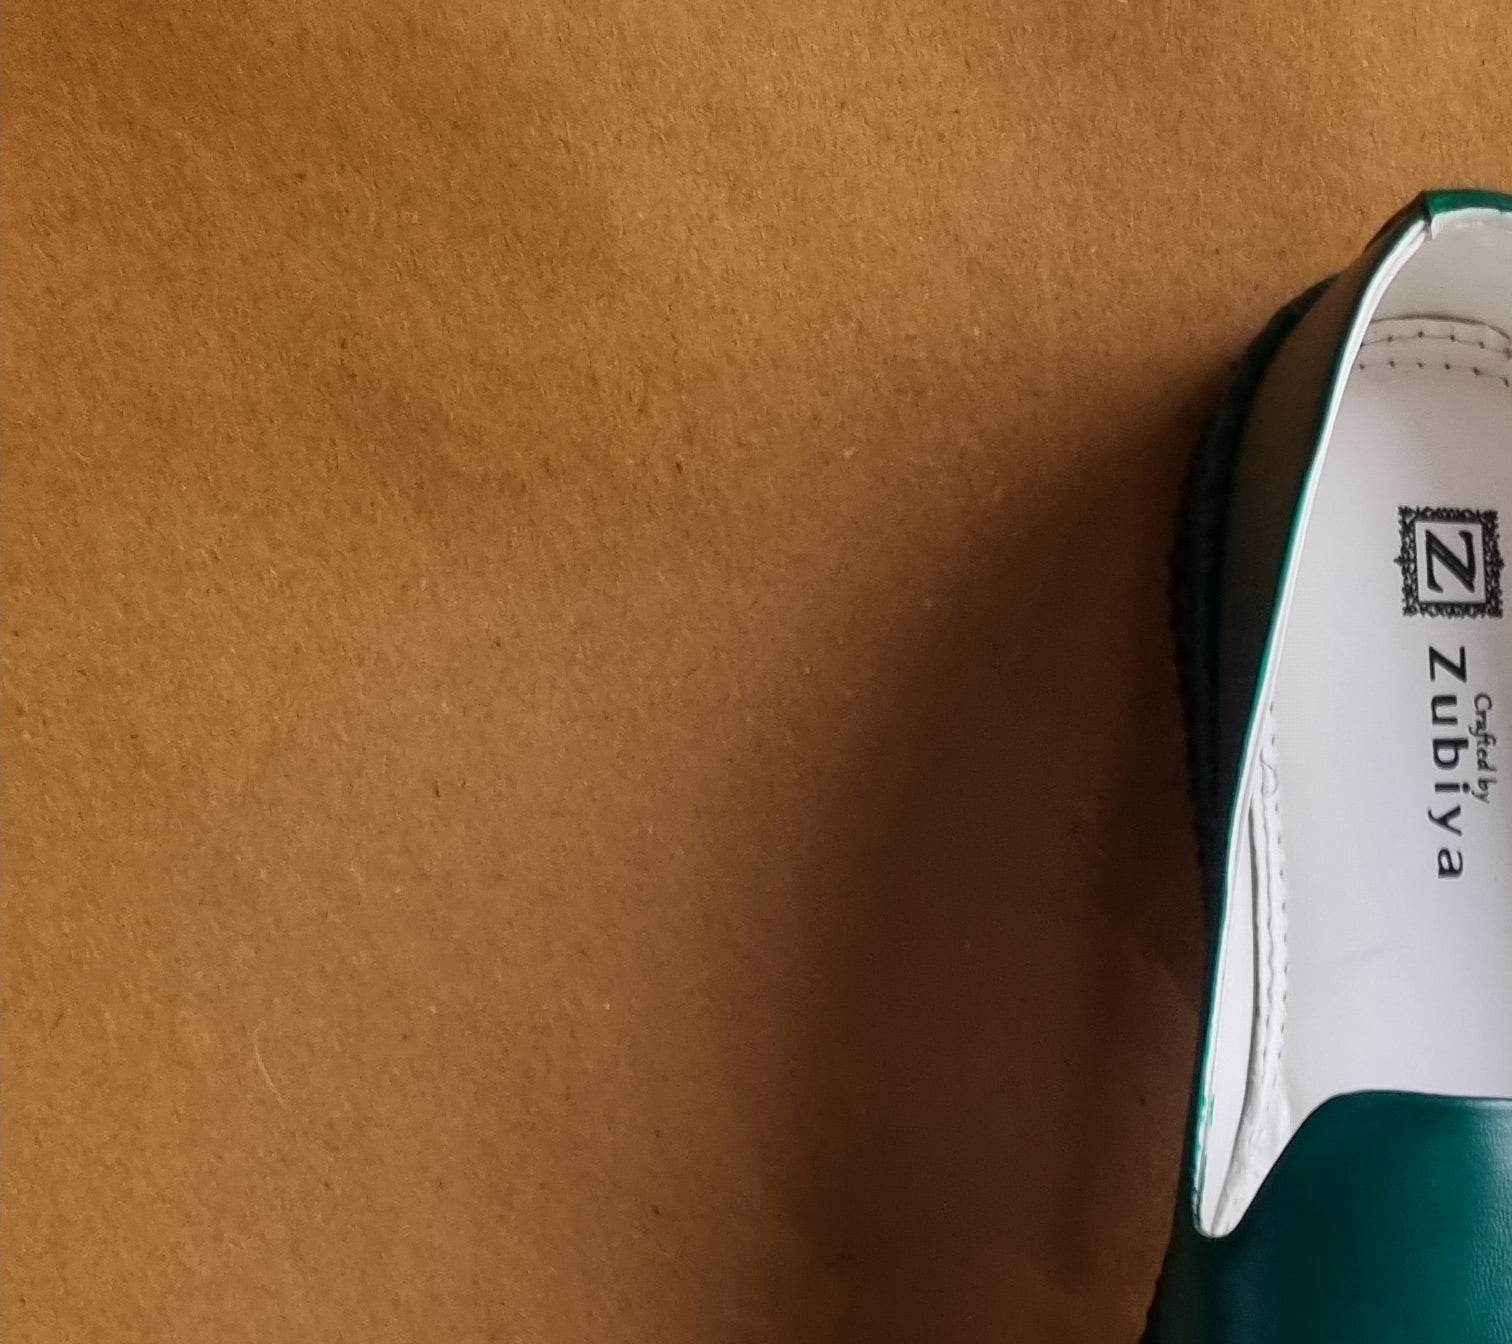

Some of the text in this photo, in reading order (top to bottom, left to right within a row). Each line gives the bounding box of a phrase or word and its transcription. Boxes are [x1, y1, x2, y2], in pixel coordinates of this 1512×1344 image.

[1428, 645, 1471, 880] Zubiya
[1468, 692, 1498, 804] Crafted by
